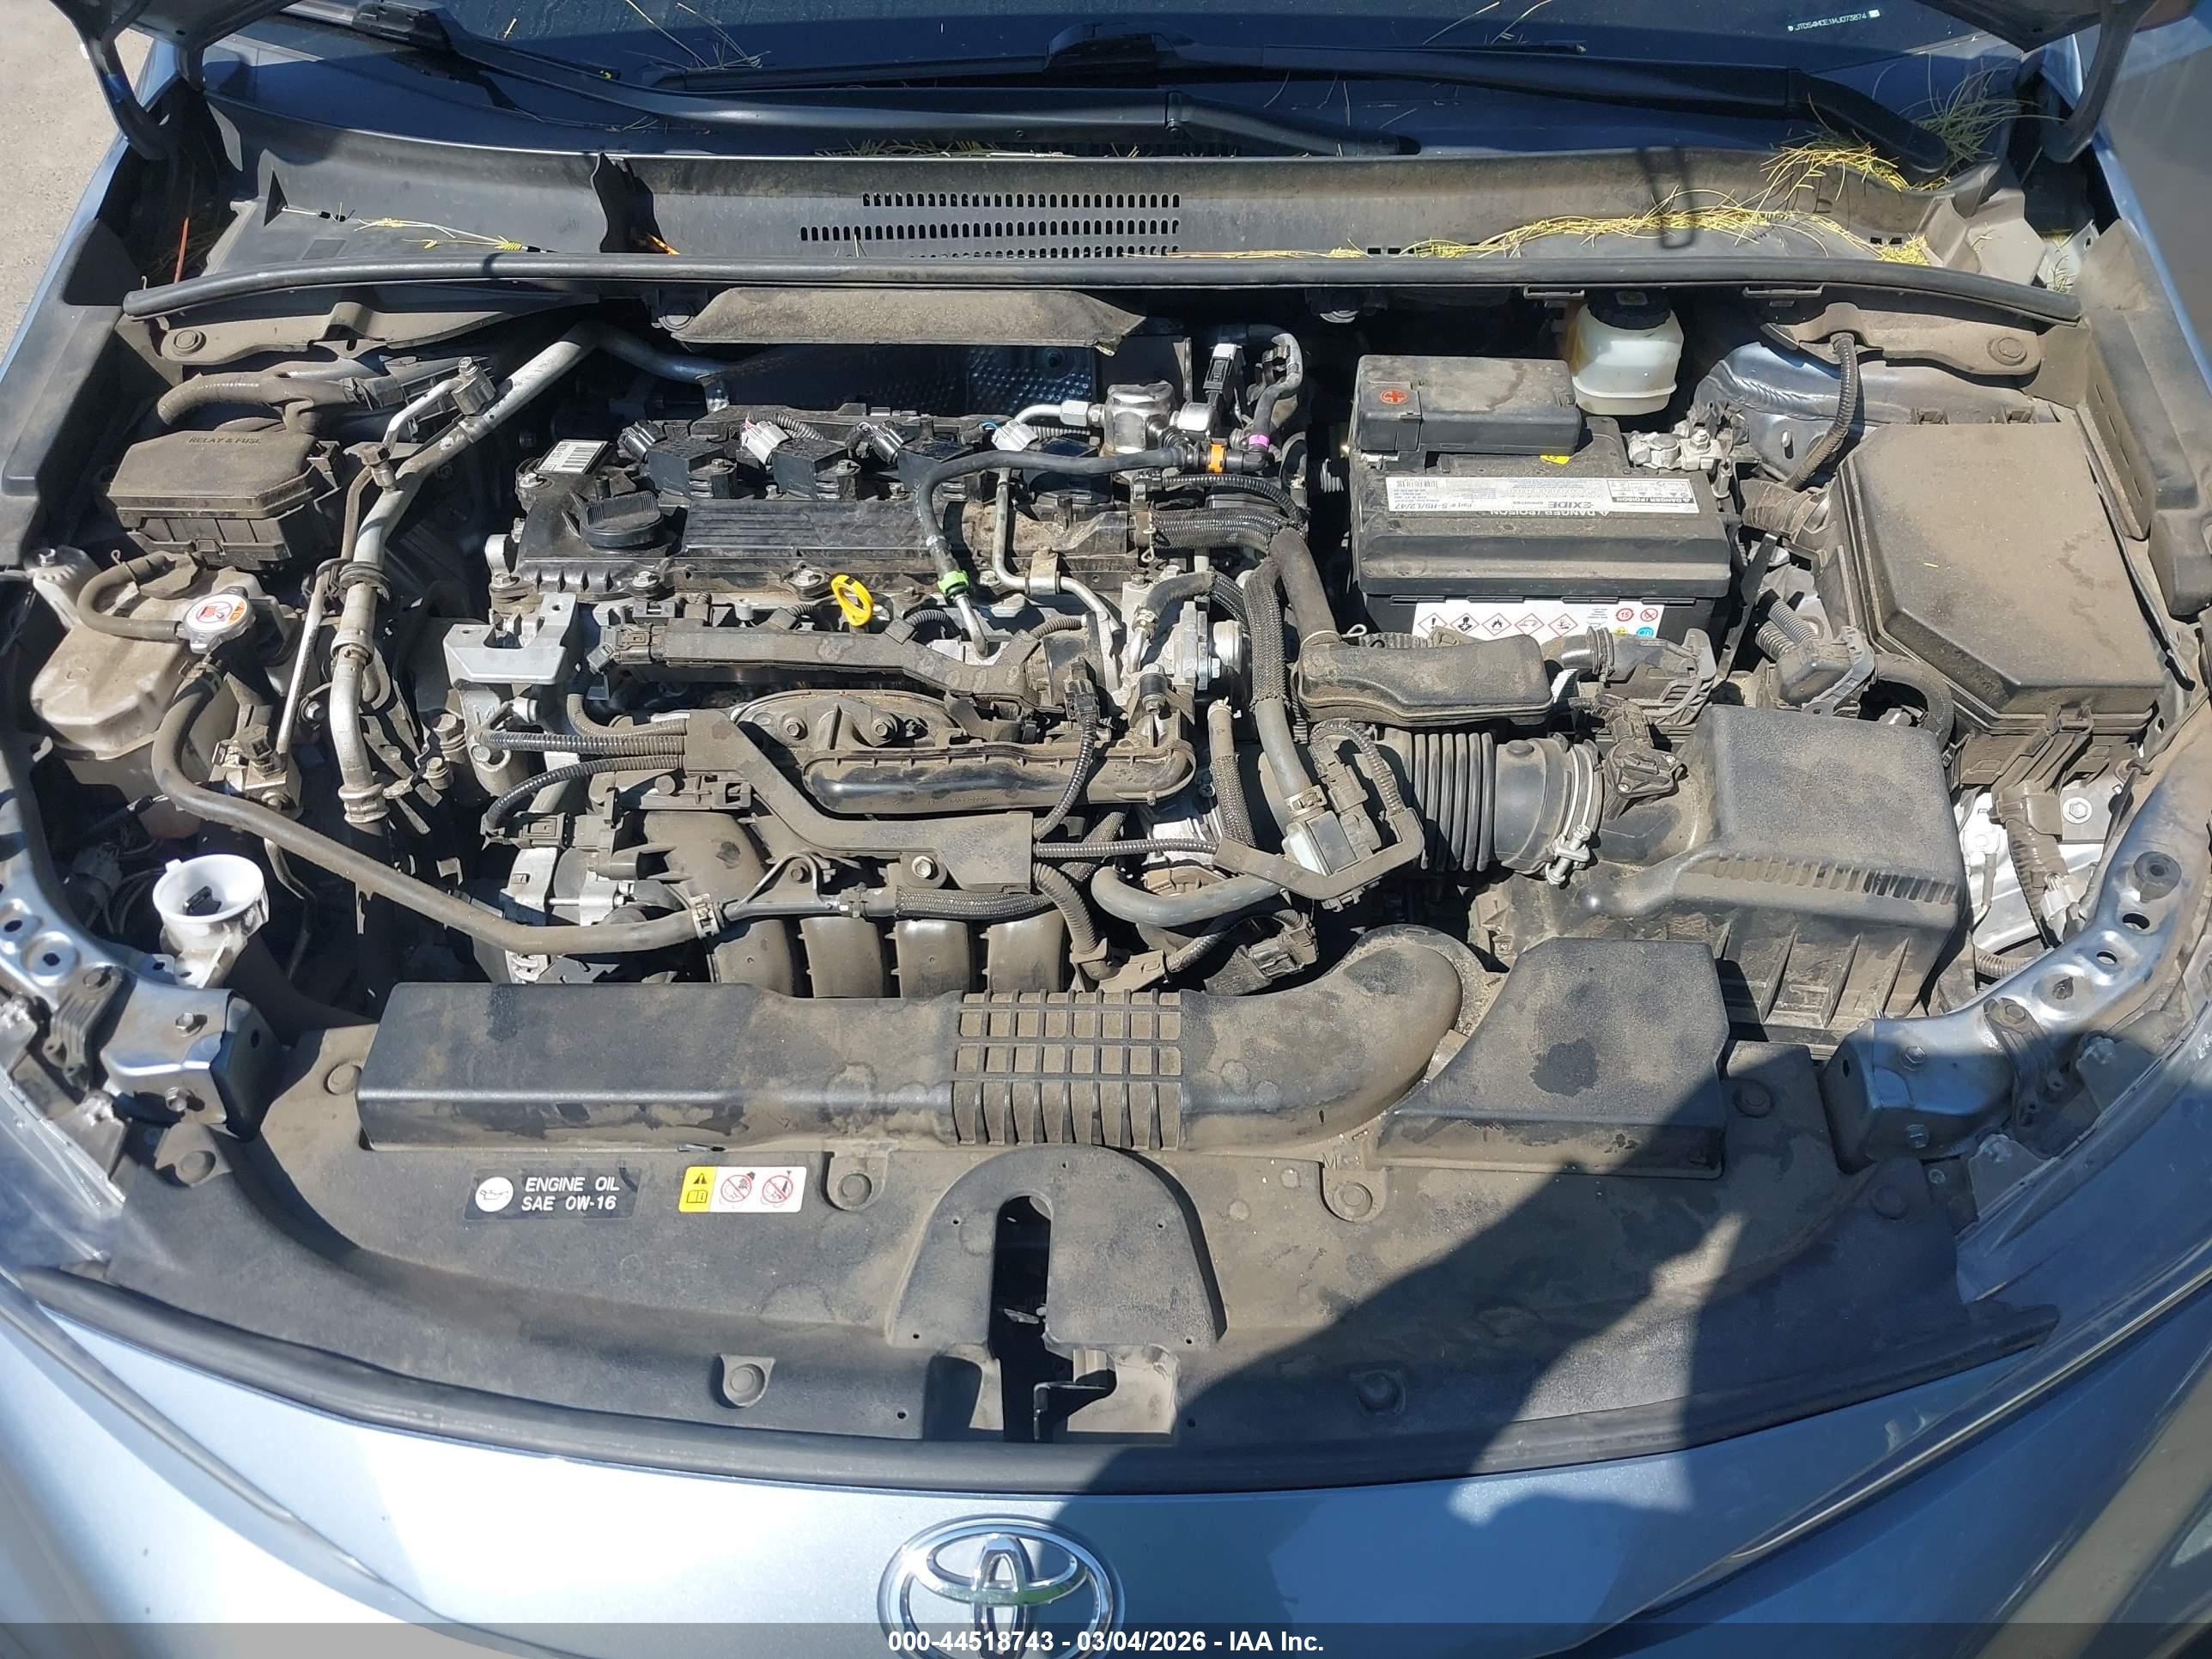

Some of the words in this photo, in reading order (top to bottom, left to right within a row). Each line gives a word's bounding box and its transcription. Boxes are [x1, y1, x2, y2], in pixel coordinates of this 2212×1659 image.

[235, 436, 262, 445] FUSE
[525, 1177, 585, 1191] ENGINE
[595, 1177, 620, 1191] OIL
[520, 1196, 556, 1211] SAE
[565, 1196, 617, 1210] 0W-16
